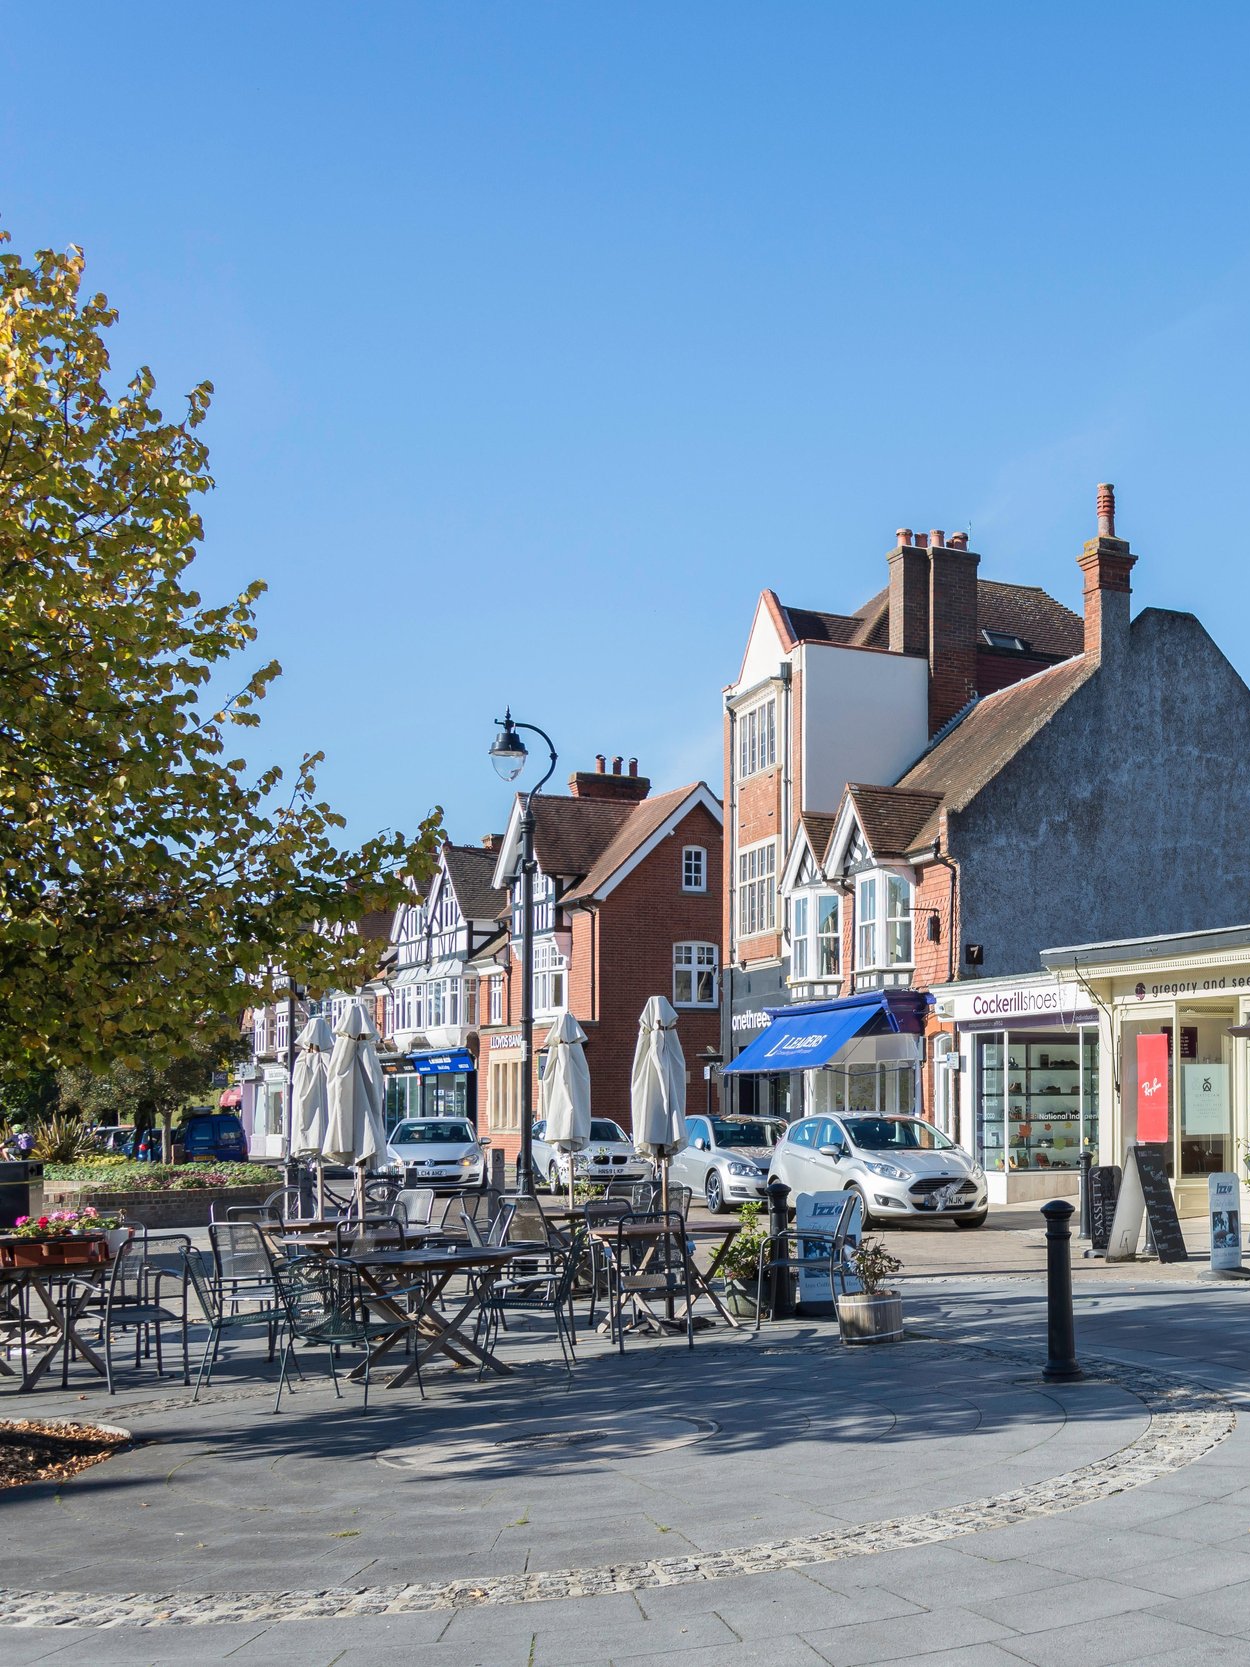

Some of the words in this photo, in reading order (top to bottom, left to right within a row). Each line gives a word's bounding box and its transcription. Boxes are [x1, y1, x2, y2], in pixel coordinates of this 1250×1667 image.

[1152, 981, 1197, 998] gregory
[1203, 977, 1226, 991] and
[490, 1035, 509, 1049] LLOYDS
[782, 1034, 828, 1050] LEADERS
[1039, 1112, 1068, 1121] National
[948, 1196, 963, 1205] NJK
[1092, 1170, 1105, 1236] SASSETTA
